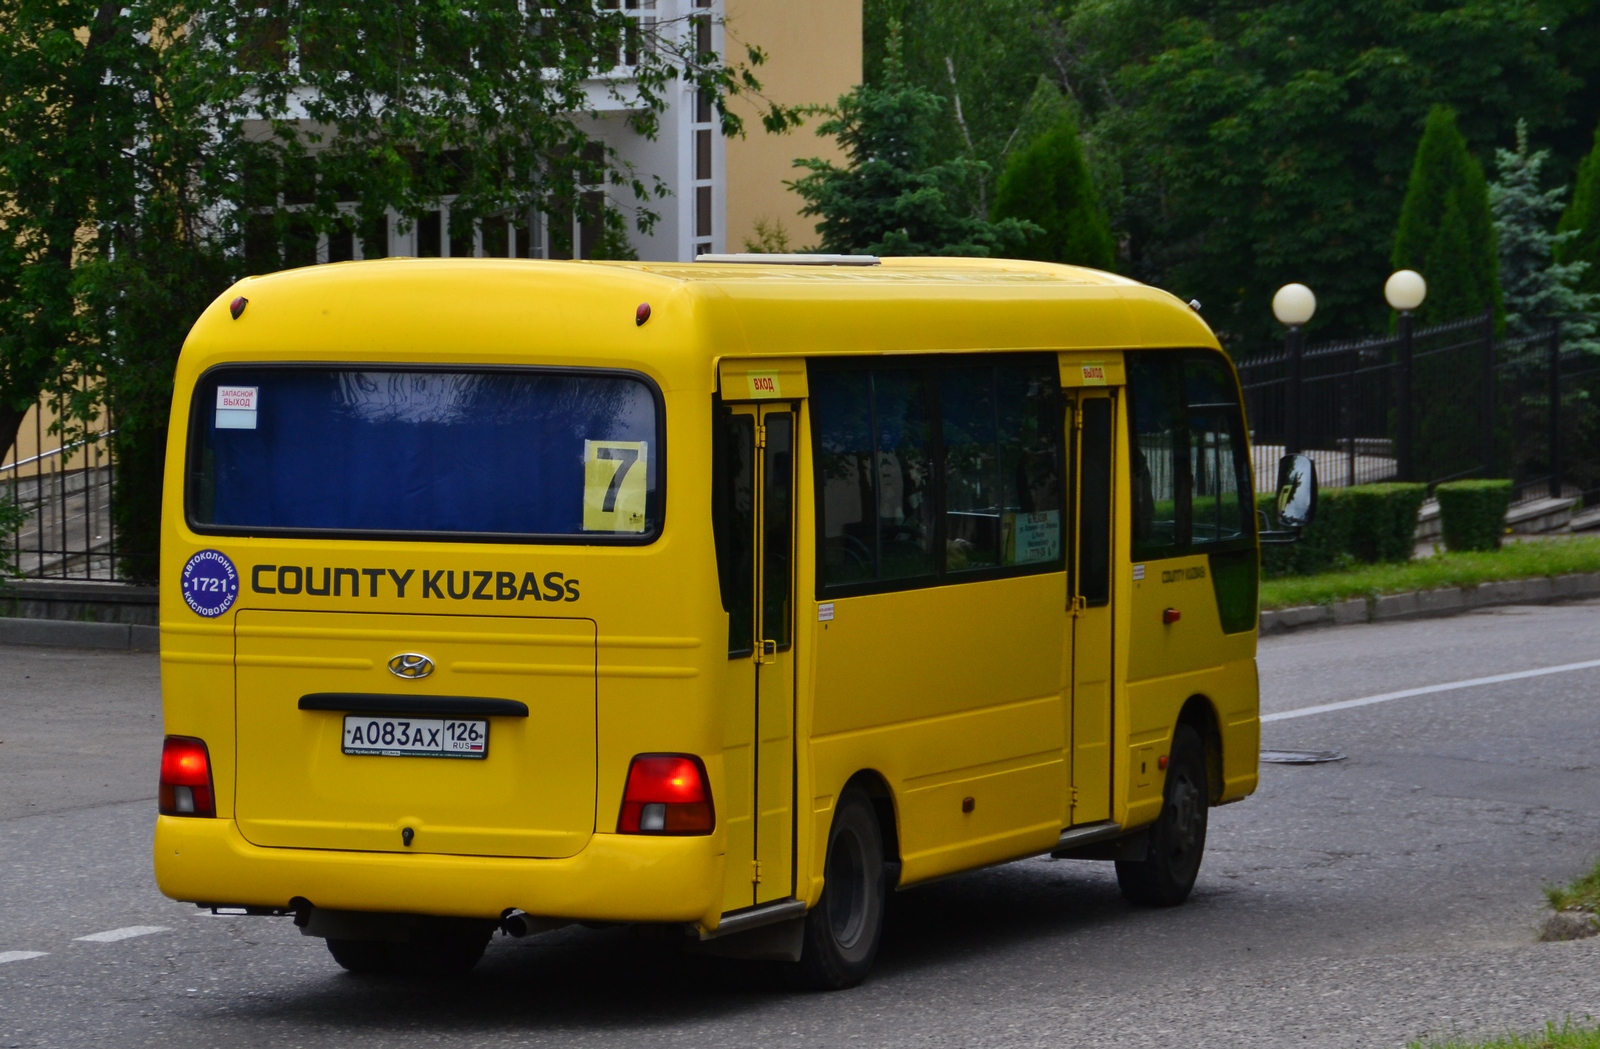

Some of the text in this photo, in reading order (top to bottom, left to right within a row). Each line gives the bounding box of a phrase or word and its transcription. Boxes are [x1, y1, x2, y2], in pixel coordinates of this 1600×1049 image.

[753, 377, 774, 392] ВХОД
[223, 398, 251, 407] ВЫХОД
[597, 447, 639, 512] 7
[184, 551, 235, 580] АВТОКОЛОННА
[191, 577, 228, 592] 1721
[184, 591, 234, 616] КИСЛОВОДСК
[351, 721, 479, 747] А083АХ 126
[452, 742, 470, 750] RUS
